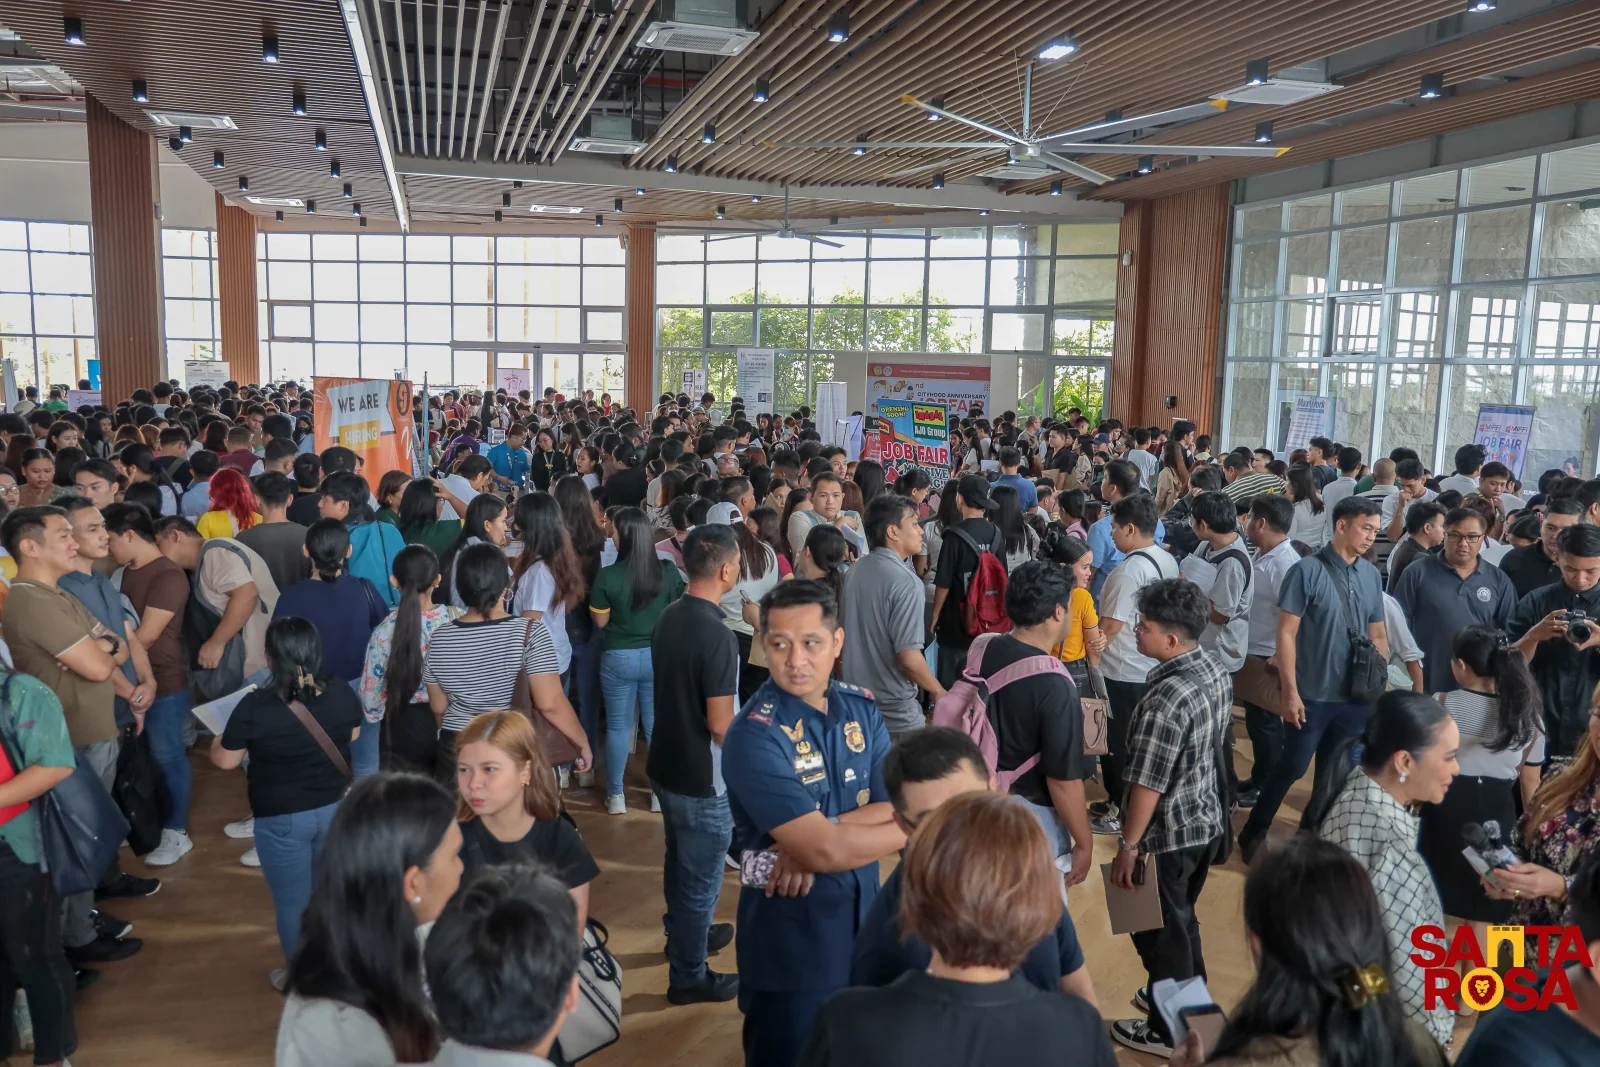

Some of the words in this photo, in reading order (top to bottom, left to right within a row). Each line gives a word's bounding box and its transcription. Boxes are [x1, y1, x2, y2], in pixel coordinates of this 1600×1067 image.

[337, 397, 355, 414] WE
[359, 393, 379, 410] ARE
[880, 405, 910, 413] OPENING
[344, 427, 379, 445] HIRING
[914, 425, 926, 436] AJO
[927, 427, 946, 438] Group
[1480, 436, 1497, 448] JOB
[1498, 437, 1523, 450] FAIR
[882, 441, 914, 460] JOB
[917, 445, 949, 465] FAIR
[904, 463, 949, 479] MSIVE
